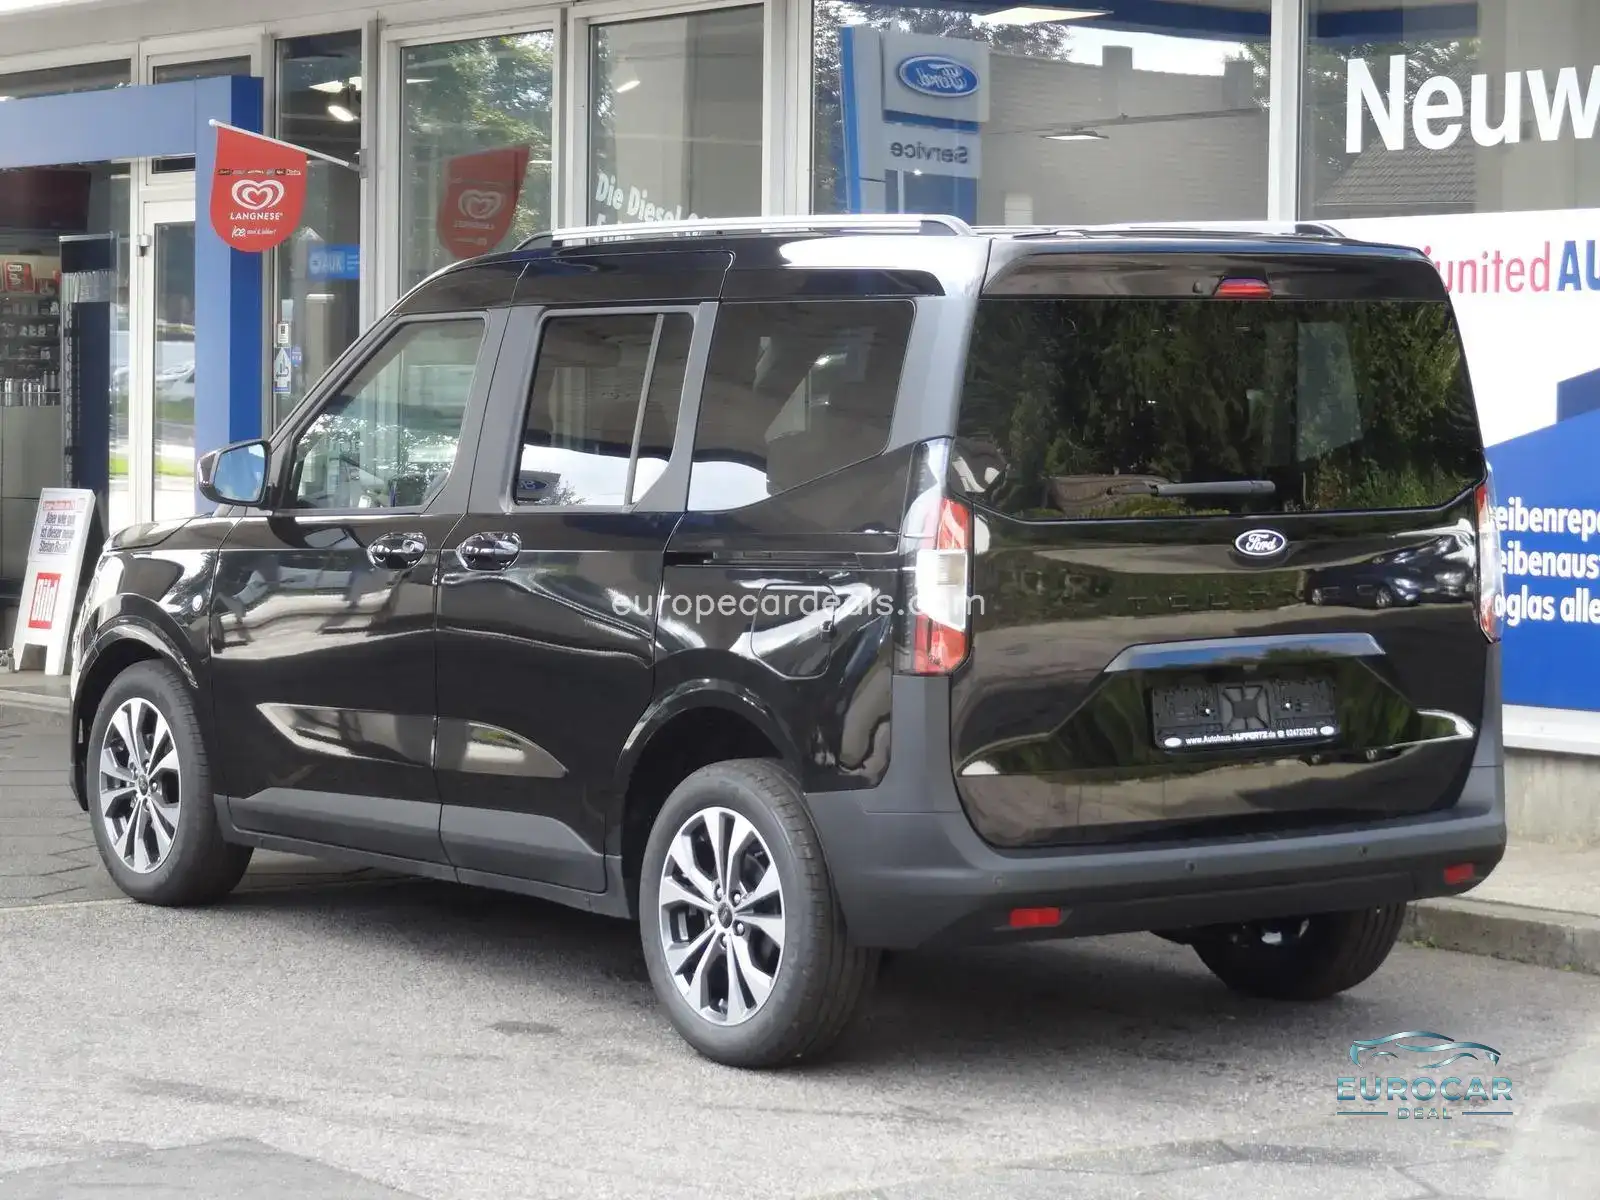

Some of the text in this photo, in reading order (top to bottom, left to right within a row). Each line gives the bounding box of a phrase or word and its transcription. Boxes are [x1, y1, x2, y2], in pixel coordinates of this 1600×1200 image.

[595, 172, 624, 210] Die
[229, 211, 281, 220] LANGNESE
[1495, 497, 1600, 542] eibenrep
[1500, 540, 1600, 579] eibenaus
